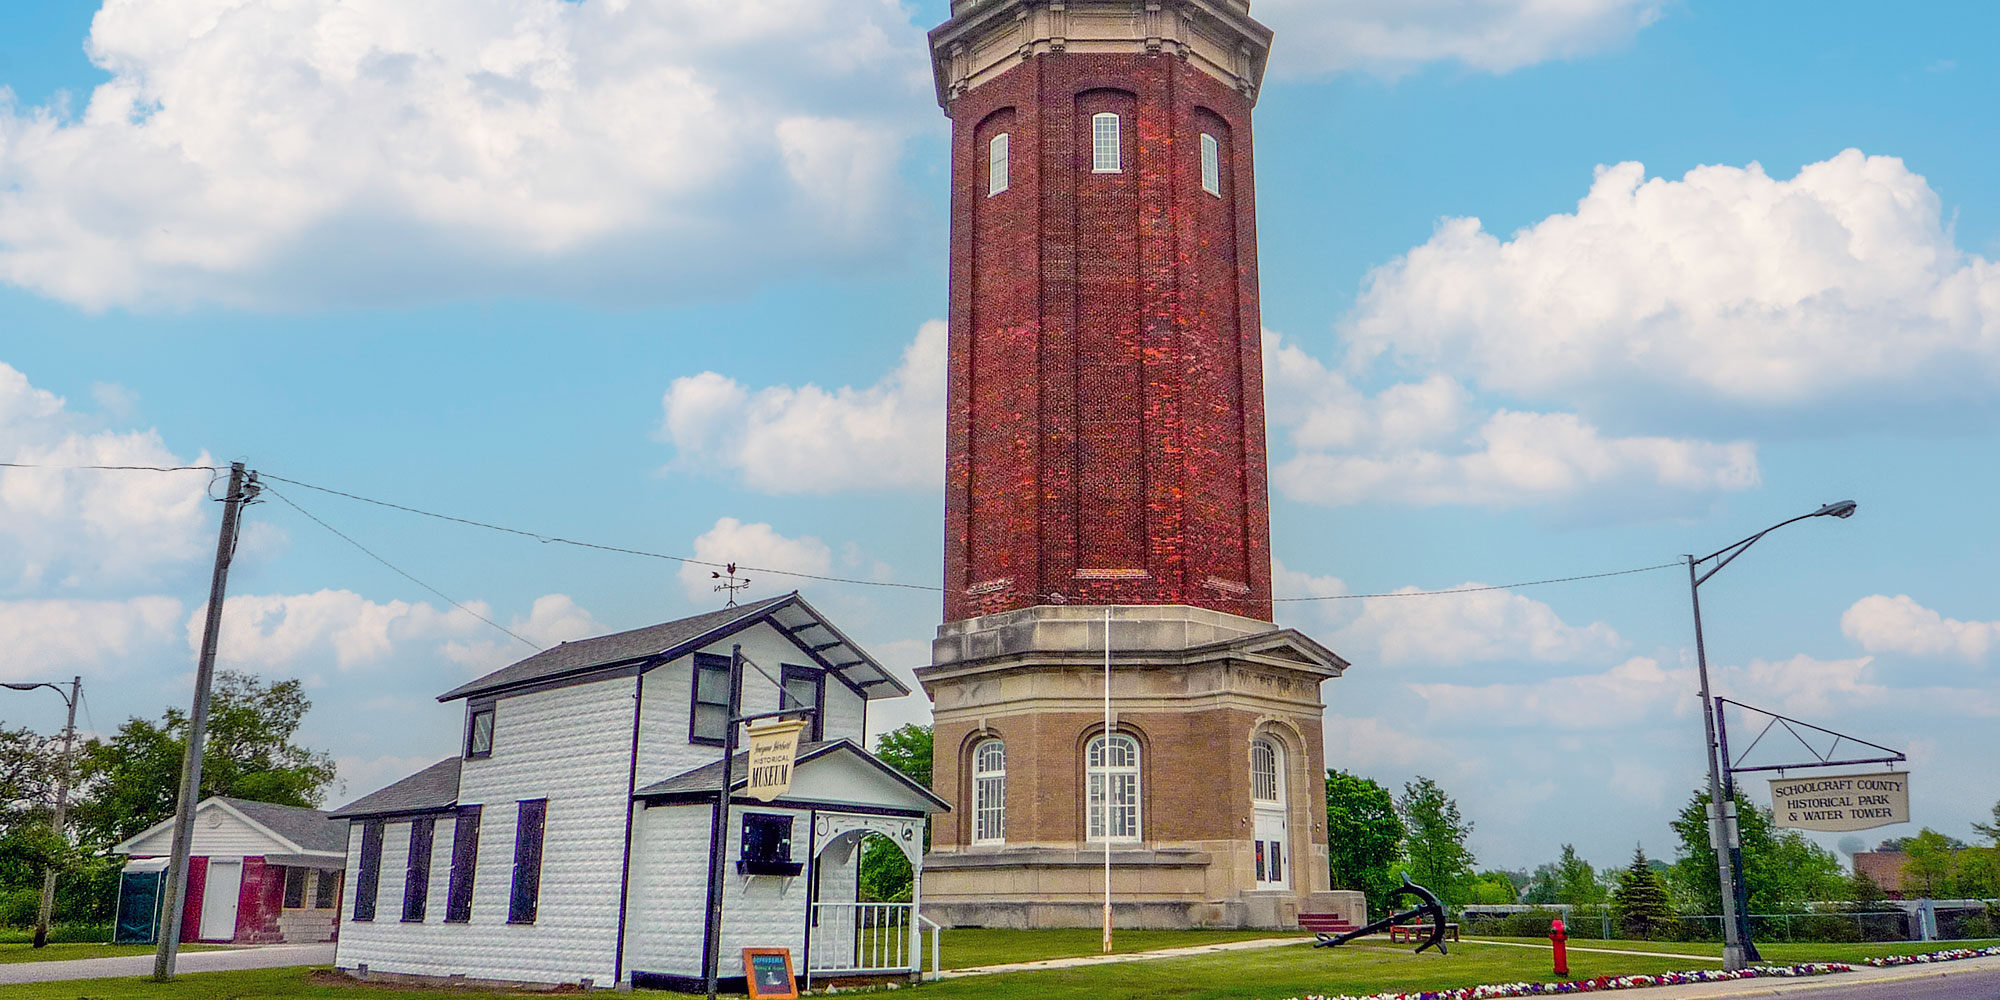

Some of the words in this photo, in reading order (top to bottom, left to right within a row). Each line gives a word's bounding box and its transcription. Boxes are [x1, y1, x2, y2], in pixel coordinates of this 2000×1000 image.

[754, 755, 790, 764] HISTORICAL
[751, 764, 788, 788] MUSEUM
[1775, 780, 1853, 798] SCHOOLCRAFT
[1857, 780, 1903, 792] COUNTY
[1787, 797, 1853, 809] HISTORICAL
[1858, 795, 1890, 806] PARK
[1788, 812, 1798, 821] &
[1803, 810, 1843, 821] WATER
[1850, 808, 1892, 819] TOWER
